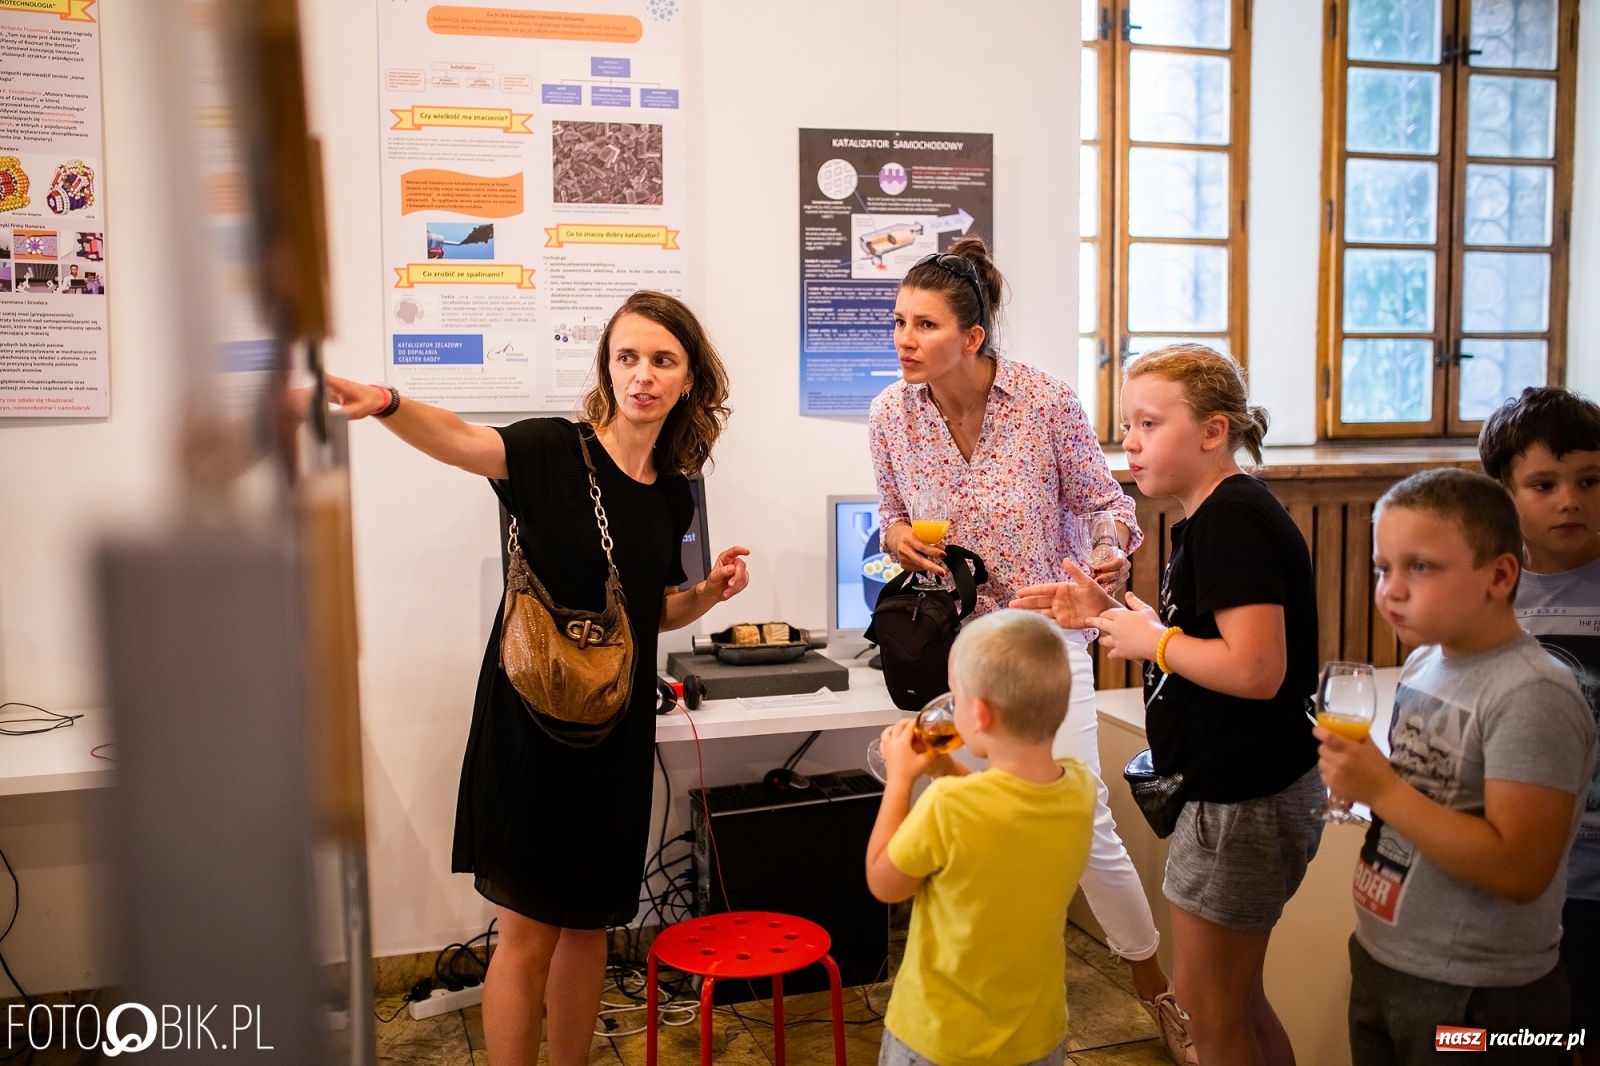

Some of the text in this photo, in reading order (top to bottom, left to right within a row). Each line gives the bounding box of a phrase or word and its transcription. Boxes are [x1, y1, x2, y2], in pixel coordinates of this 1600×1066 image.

[420, 113, 431, 121] Czy
[832, 139, 964, 150] KATALIZATOR SAMOCHODOWY
